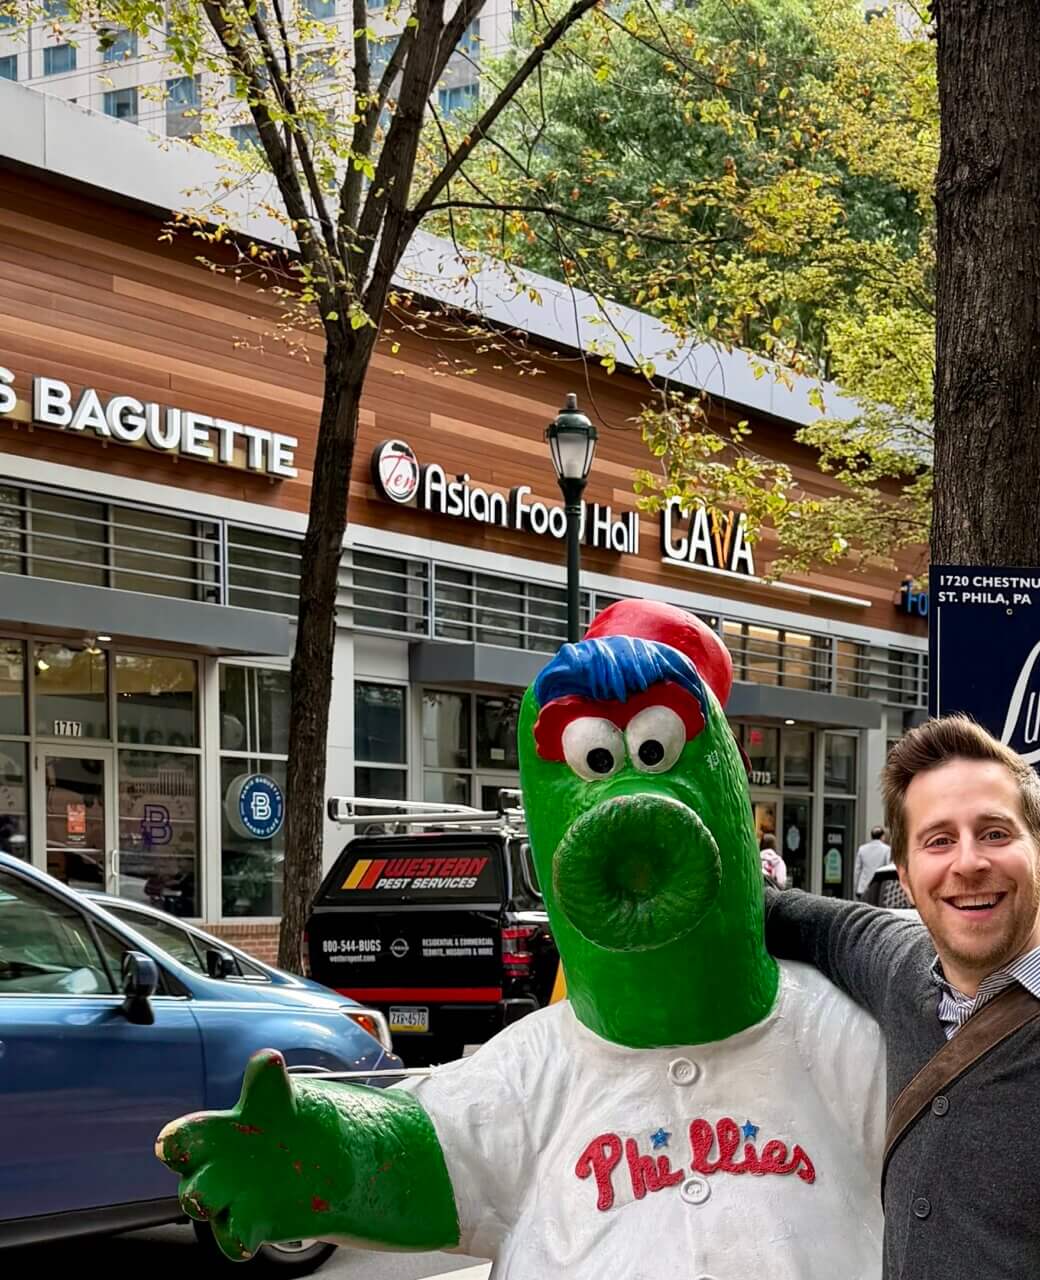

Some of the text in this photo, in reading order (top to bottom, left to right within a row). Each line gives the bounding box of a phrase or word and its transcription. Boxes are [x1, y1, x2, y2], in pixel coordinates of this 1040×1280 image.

[33, 376, 298, 478] BAGUETTE
[424, 463, 508, 528] Asian
[593, 502, 639, 554] Hall
[664, 495, 755, 575] CAVA
[940, 575, 969, 586] 1720
[938, 591, 1032, 605] ST. PHILA, PA
[54, 720, 81, 737] 1717
[384, 857, 488, 877] WESTERN
[376, 877, 478, 889] PEST SERVICES
[323, 939, 382, 952] 800-544-BUGS
[575, 1117, 816, 1211] Phillies
